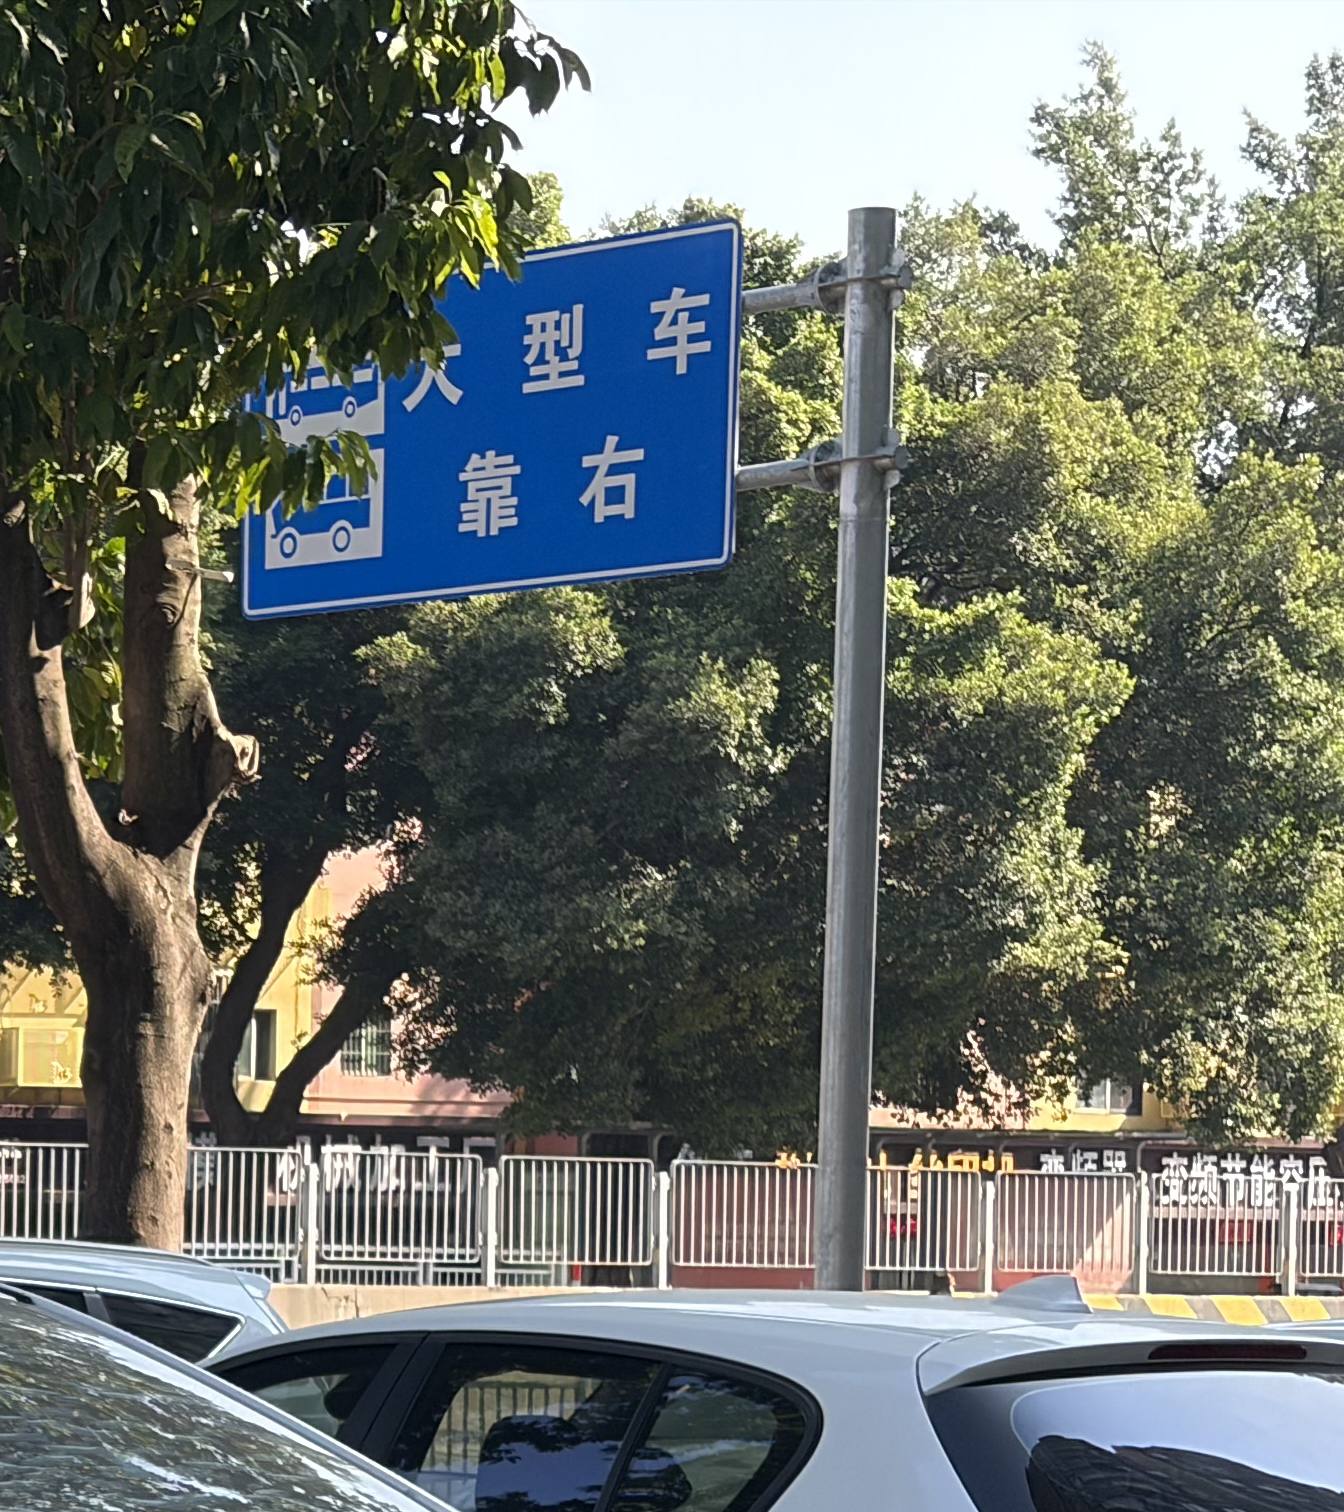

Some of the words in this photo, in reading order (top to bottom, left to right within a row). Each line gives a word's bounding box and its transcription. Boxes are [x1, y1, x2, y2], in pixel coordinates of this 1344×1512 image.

[402, 287, 711, 412] 大型车
[457, 435, 644, 537] 靠右
